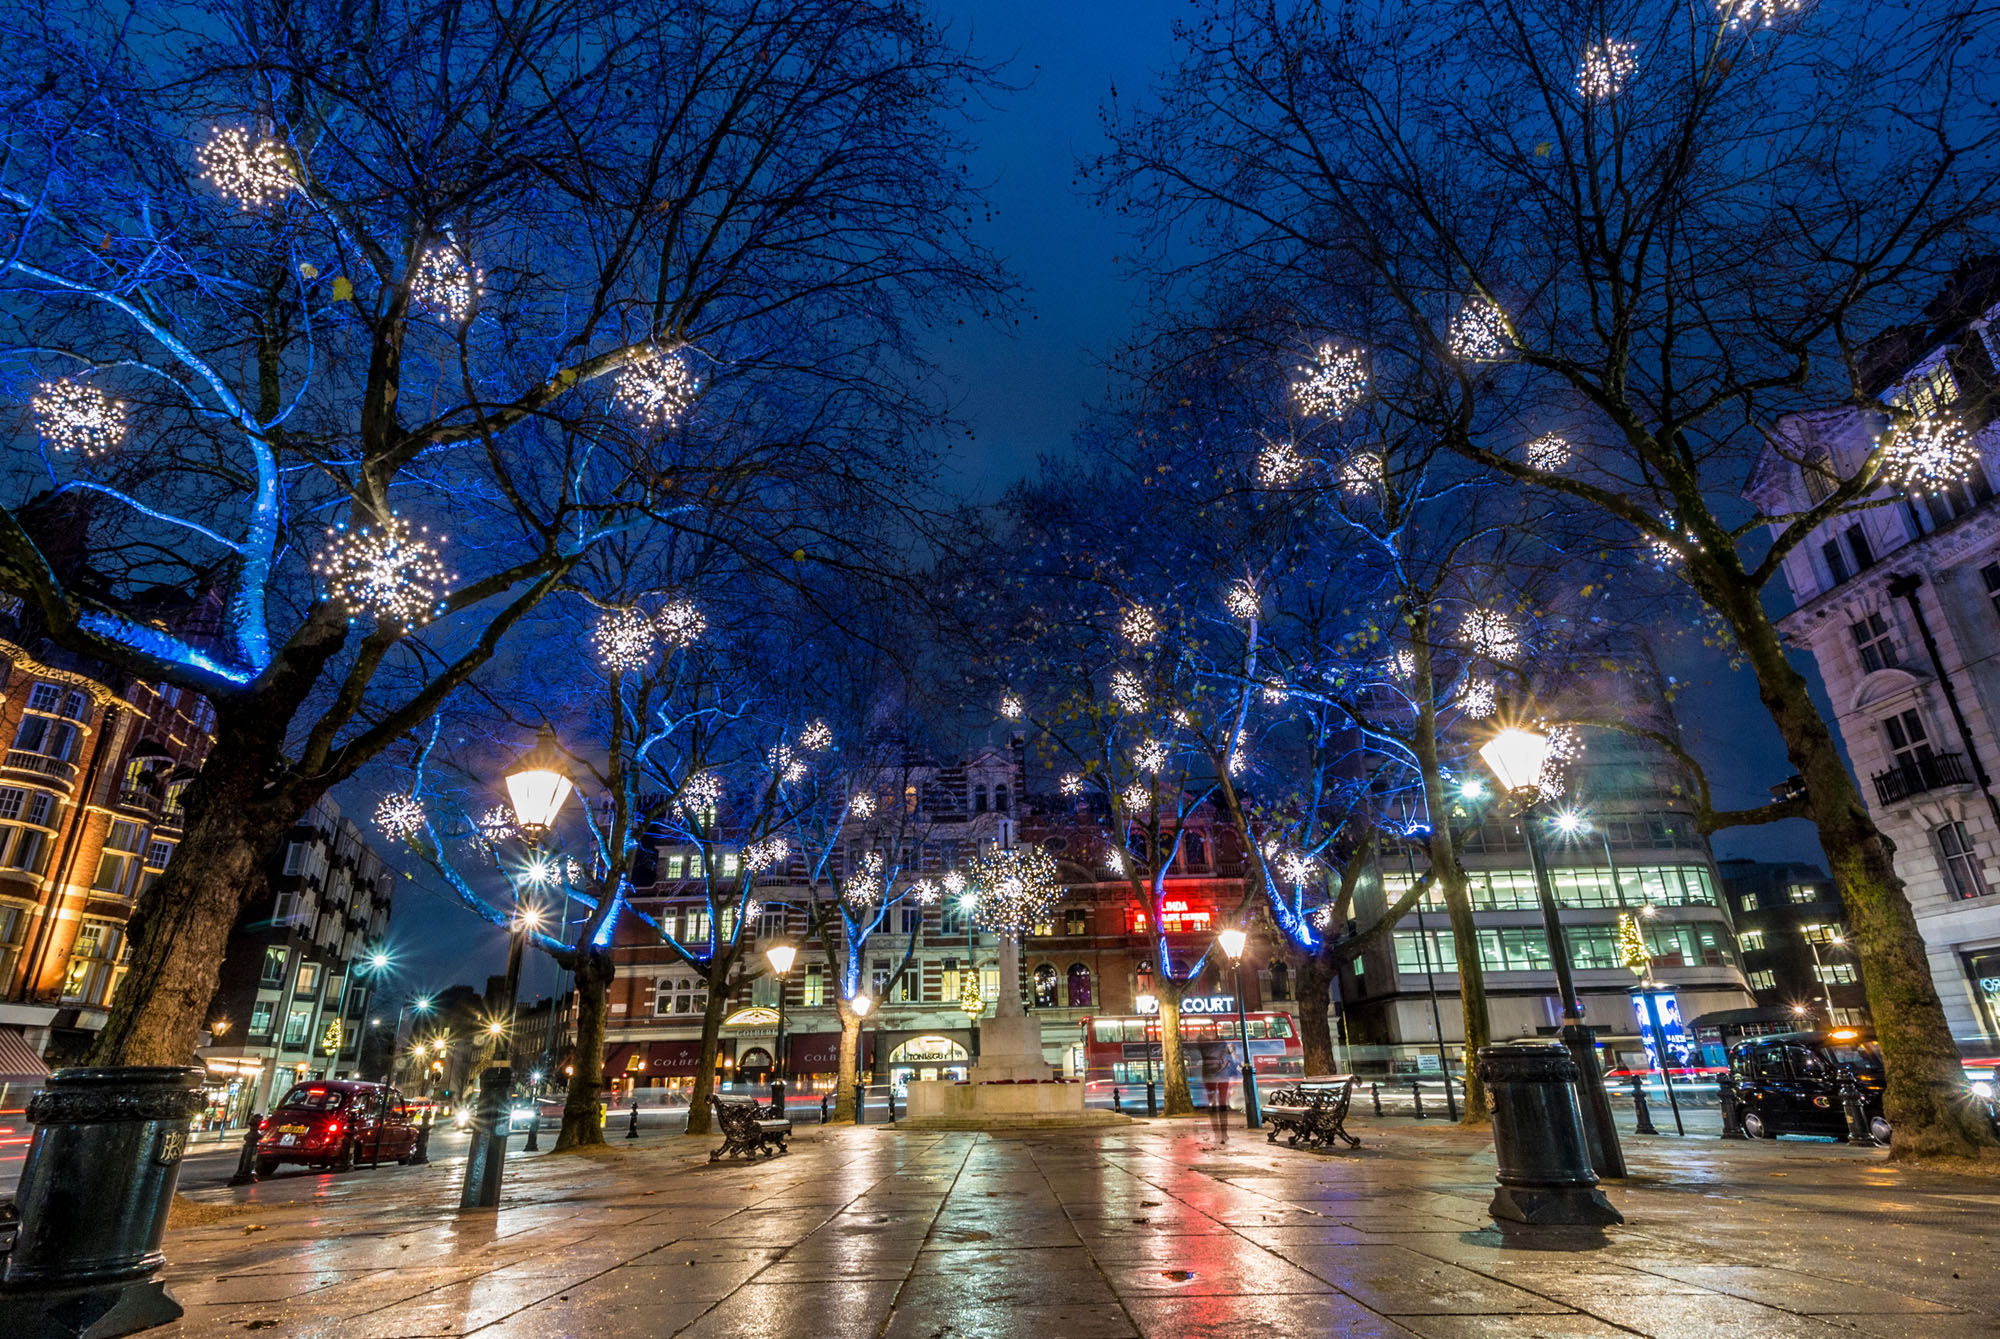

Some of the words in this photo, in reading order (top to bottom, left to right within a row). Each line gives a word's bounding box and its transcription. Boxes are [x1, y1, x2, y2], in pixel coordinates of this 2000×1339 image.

[1182, 997, 1234, 1013] COURT
[804, 1054, 837, 1062] COLB
[908, 1052, 948, 1061] TONI&GUY
